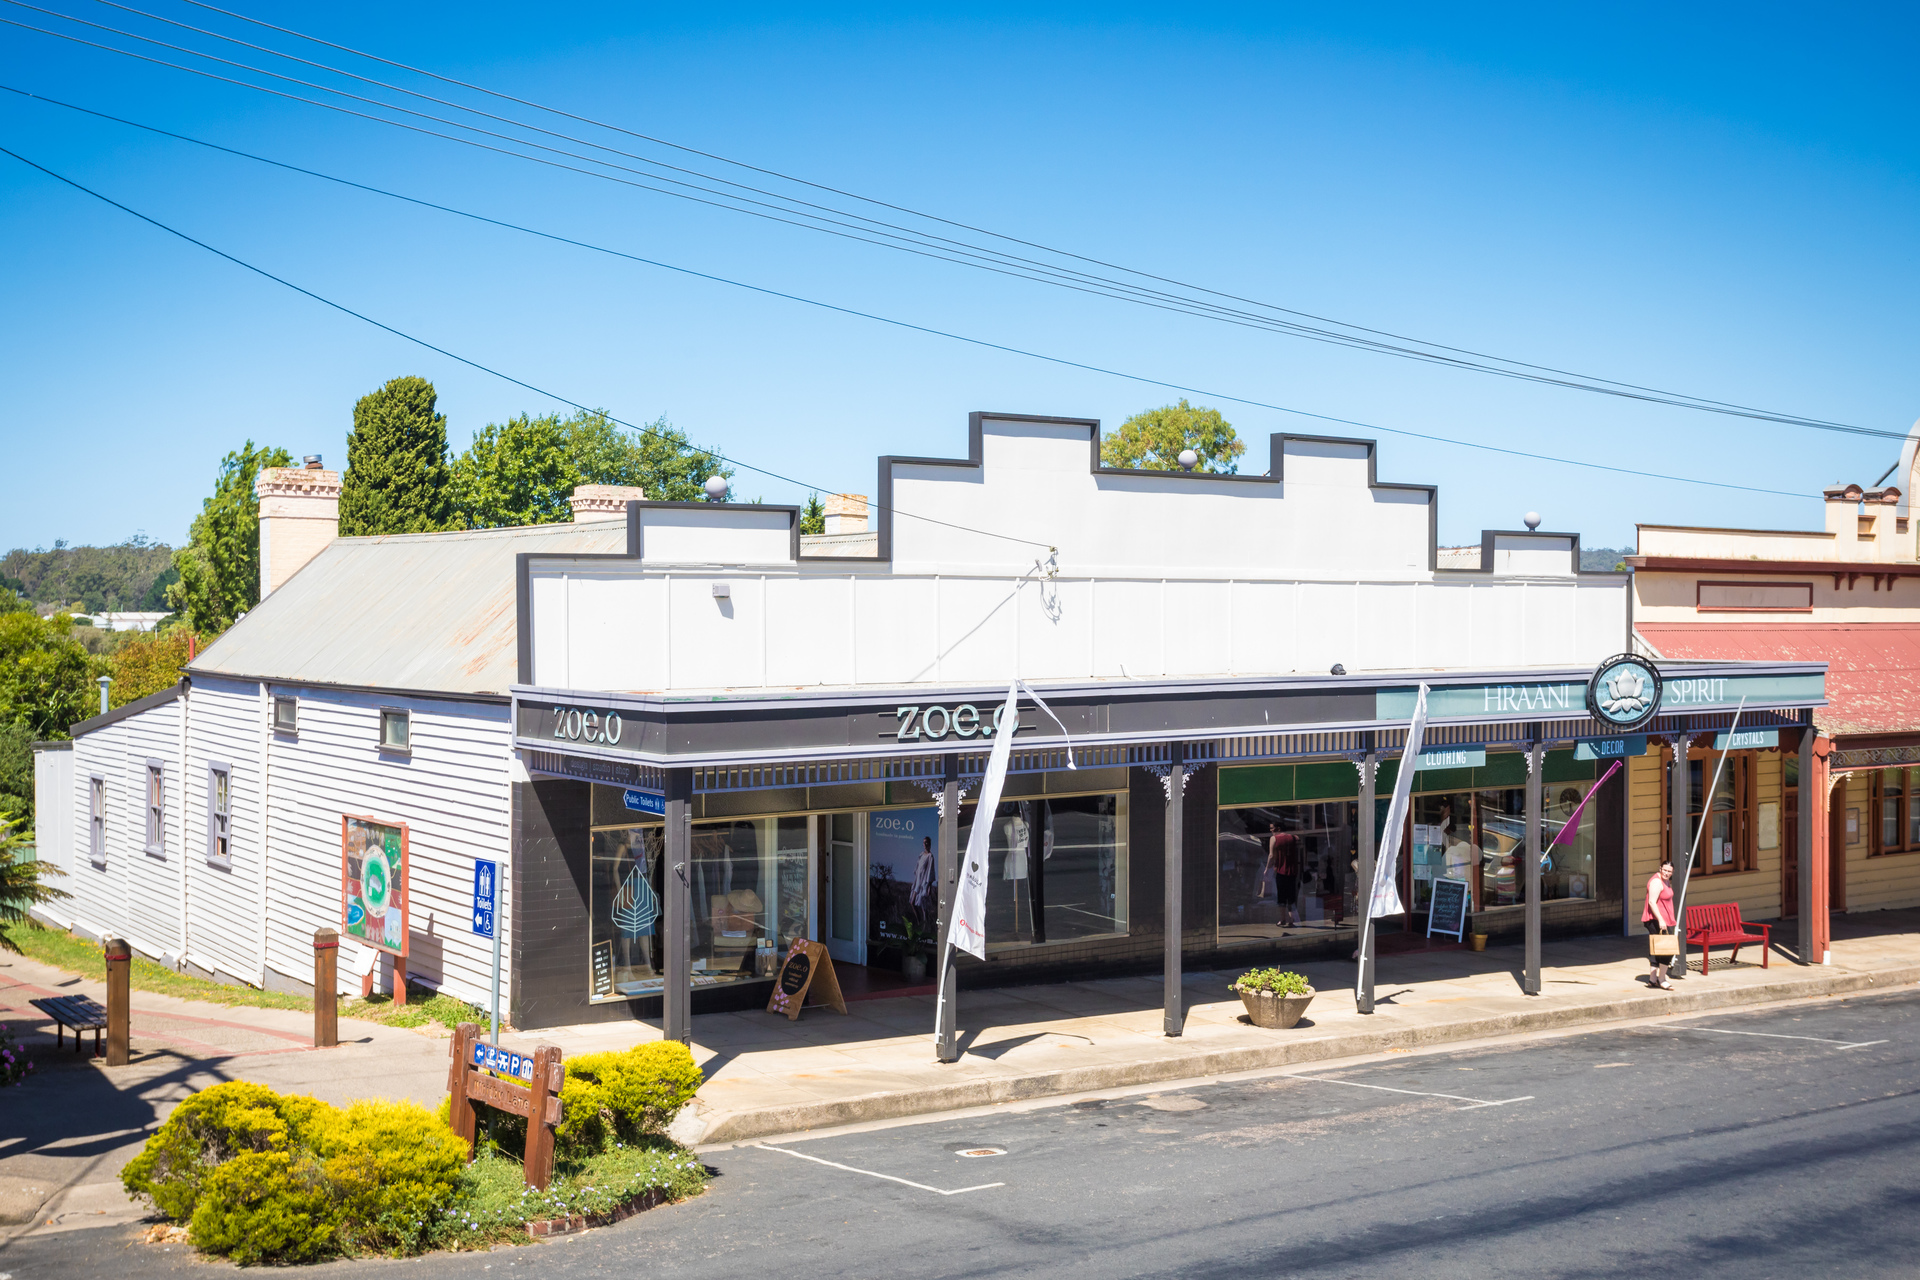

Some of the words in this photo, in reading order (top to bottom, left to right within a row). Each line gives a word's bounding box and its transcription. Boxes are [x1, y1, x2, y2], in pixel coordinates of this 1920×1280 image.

[1483, 682, 1570, 712] HRAANI
[1670, 678, 1728, 704] SPIRIT
[553, 706, 622, 745] zoe.o
[1732, 731, 1765, 747] CRYSTALS
[1601, 740, 1625, 756] DECOR
[1425, 750, 1467, 766] CLOTHING
[592, 763, 611, 773] studio
[615, 765, 630, 777] shop
[626, 794, 639, 804] Public
[640, 796, 654, 807] Toilets
[875, 817, 915, 832] zoe.o
[476, 896, 492, 911] Toilets
[788, 962, 808, 973] zoe.o
[507, 1090, 529, 1110] Lane
